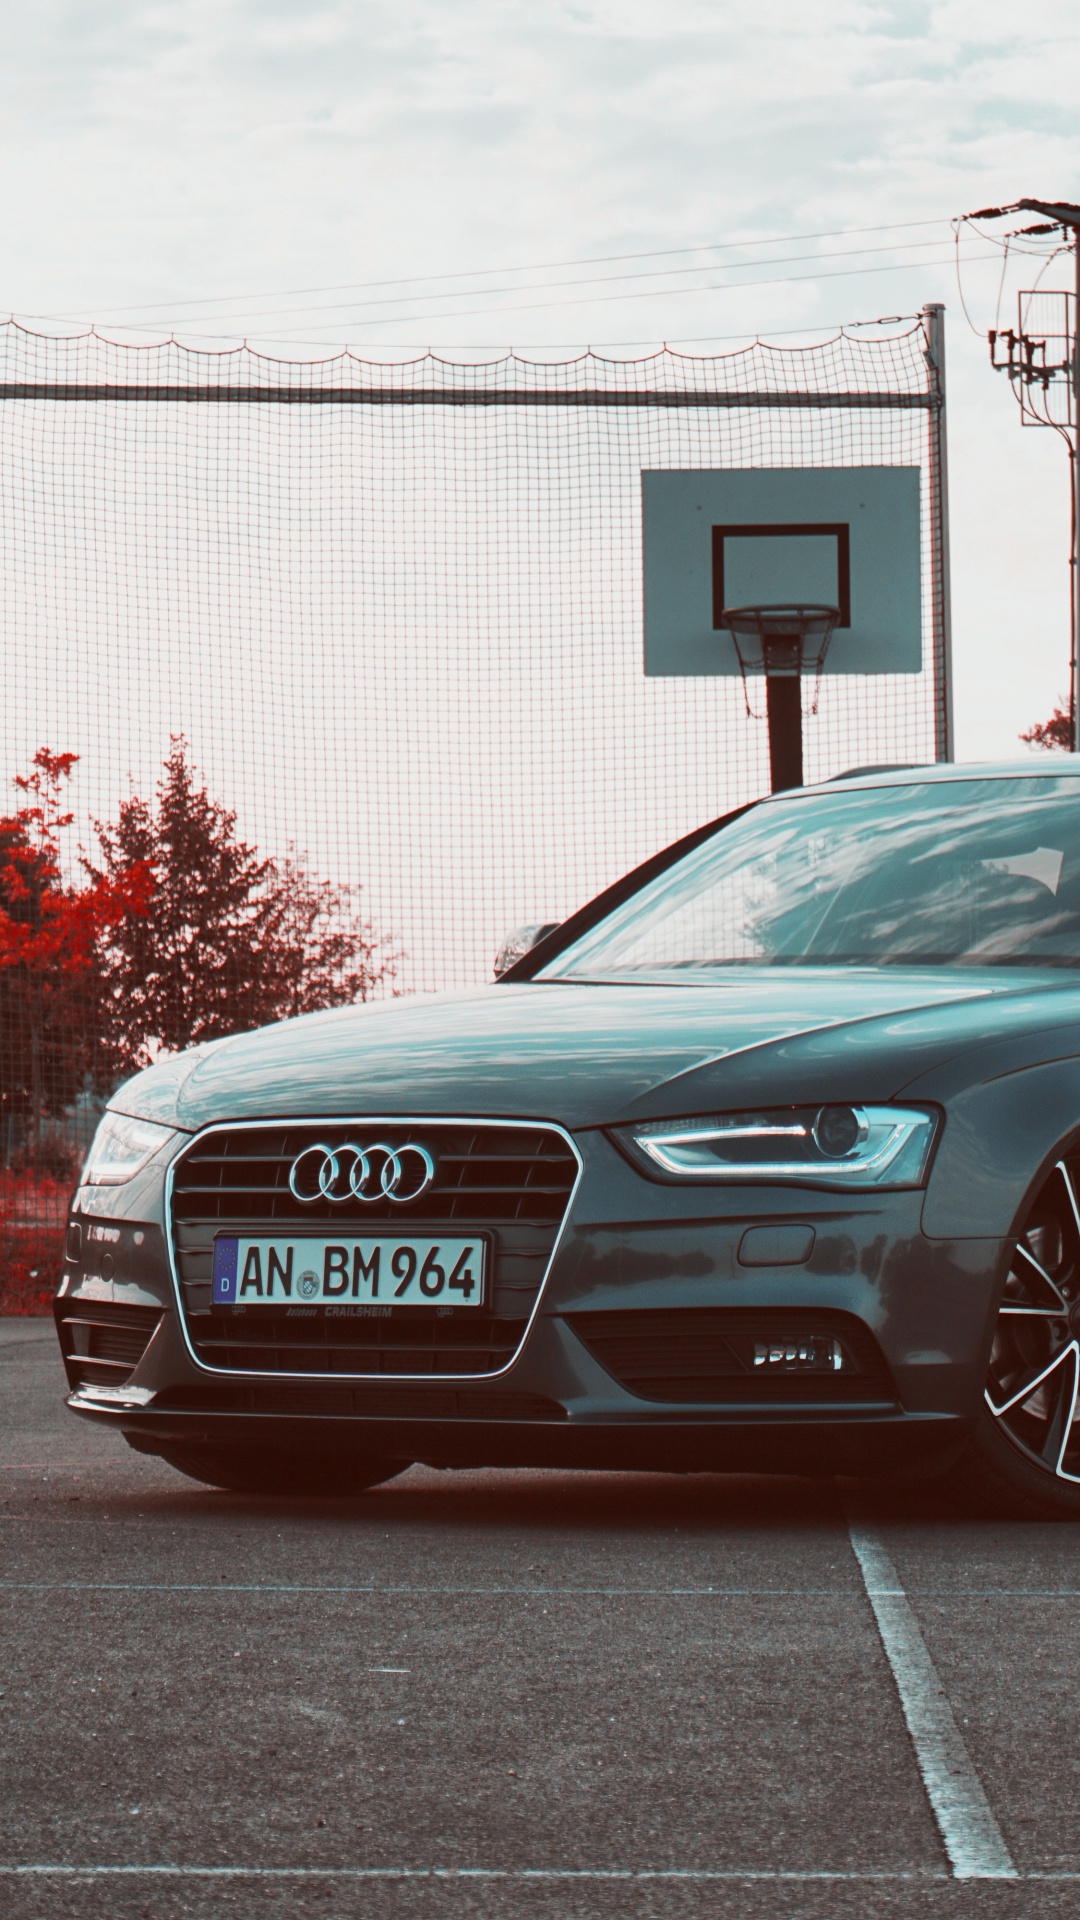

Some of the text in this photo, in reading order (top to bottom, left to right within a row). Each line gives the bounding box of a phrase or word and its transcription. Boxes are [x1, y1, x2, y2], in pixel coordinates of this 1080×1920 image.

[240, 1246, 294, 1296] AN
[323, 1246, 381, 1297] BM
[391, 1246, 475, 1298] 964
[221, 1278, 230, 1292] D
[324, 1306, 393, 1317] CRAILSHEIM
